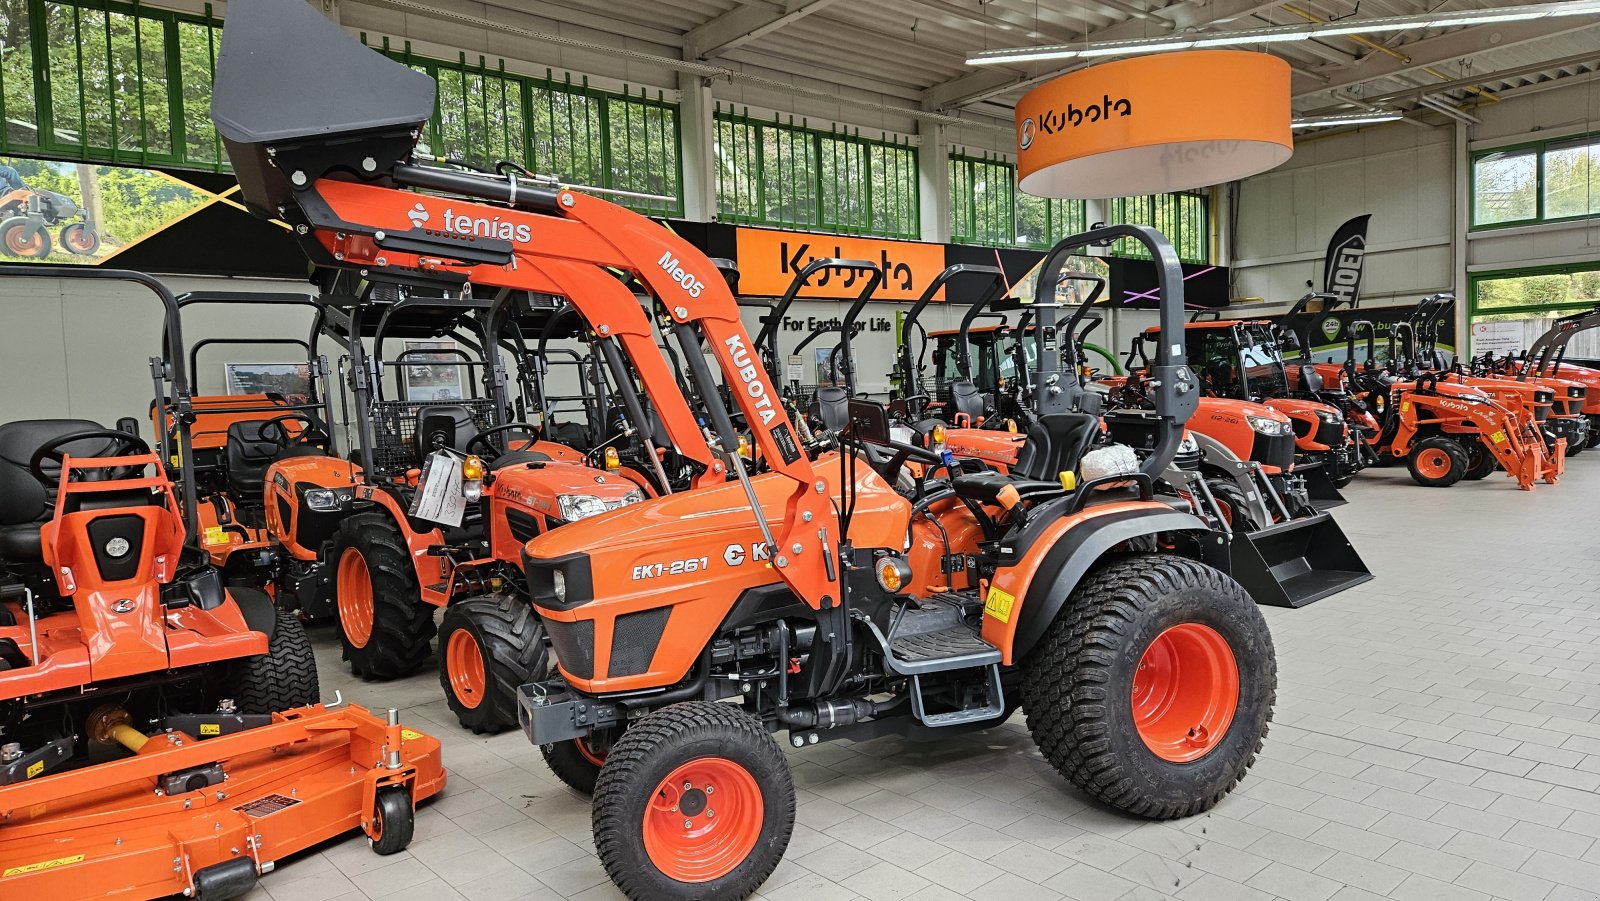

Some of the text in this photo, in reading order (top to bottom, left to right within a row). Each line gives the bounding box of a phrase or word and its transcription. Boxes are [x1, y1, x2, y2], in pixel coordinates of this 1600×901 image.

[1039, 94, 1132, 135] Kubota
[443, 208, 532, 243] tenías
[657, 250, 705, 298] Me05
[783, 316, 804, 331] For
[808, 317, 841, 331] Earth
[869, 318, 891, 332] Life
[725, 333, 777, 427] KUBOTA
[631, 556, 709, 581] EK1-261
